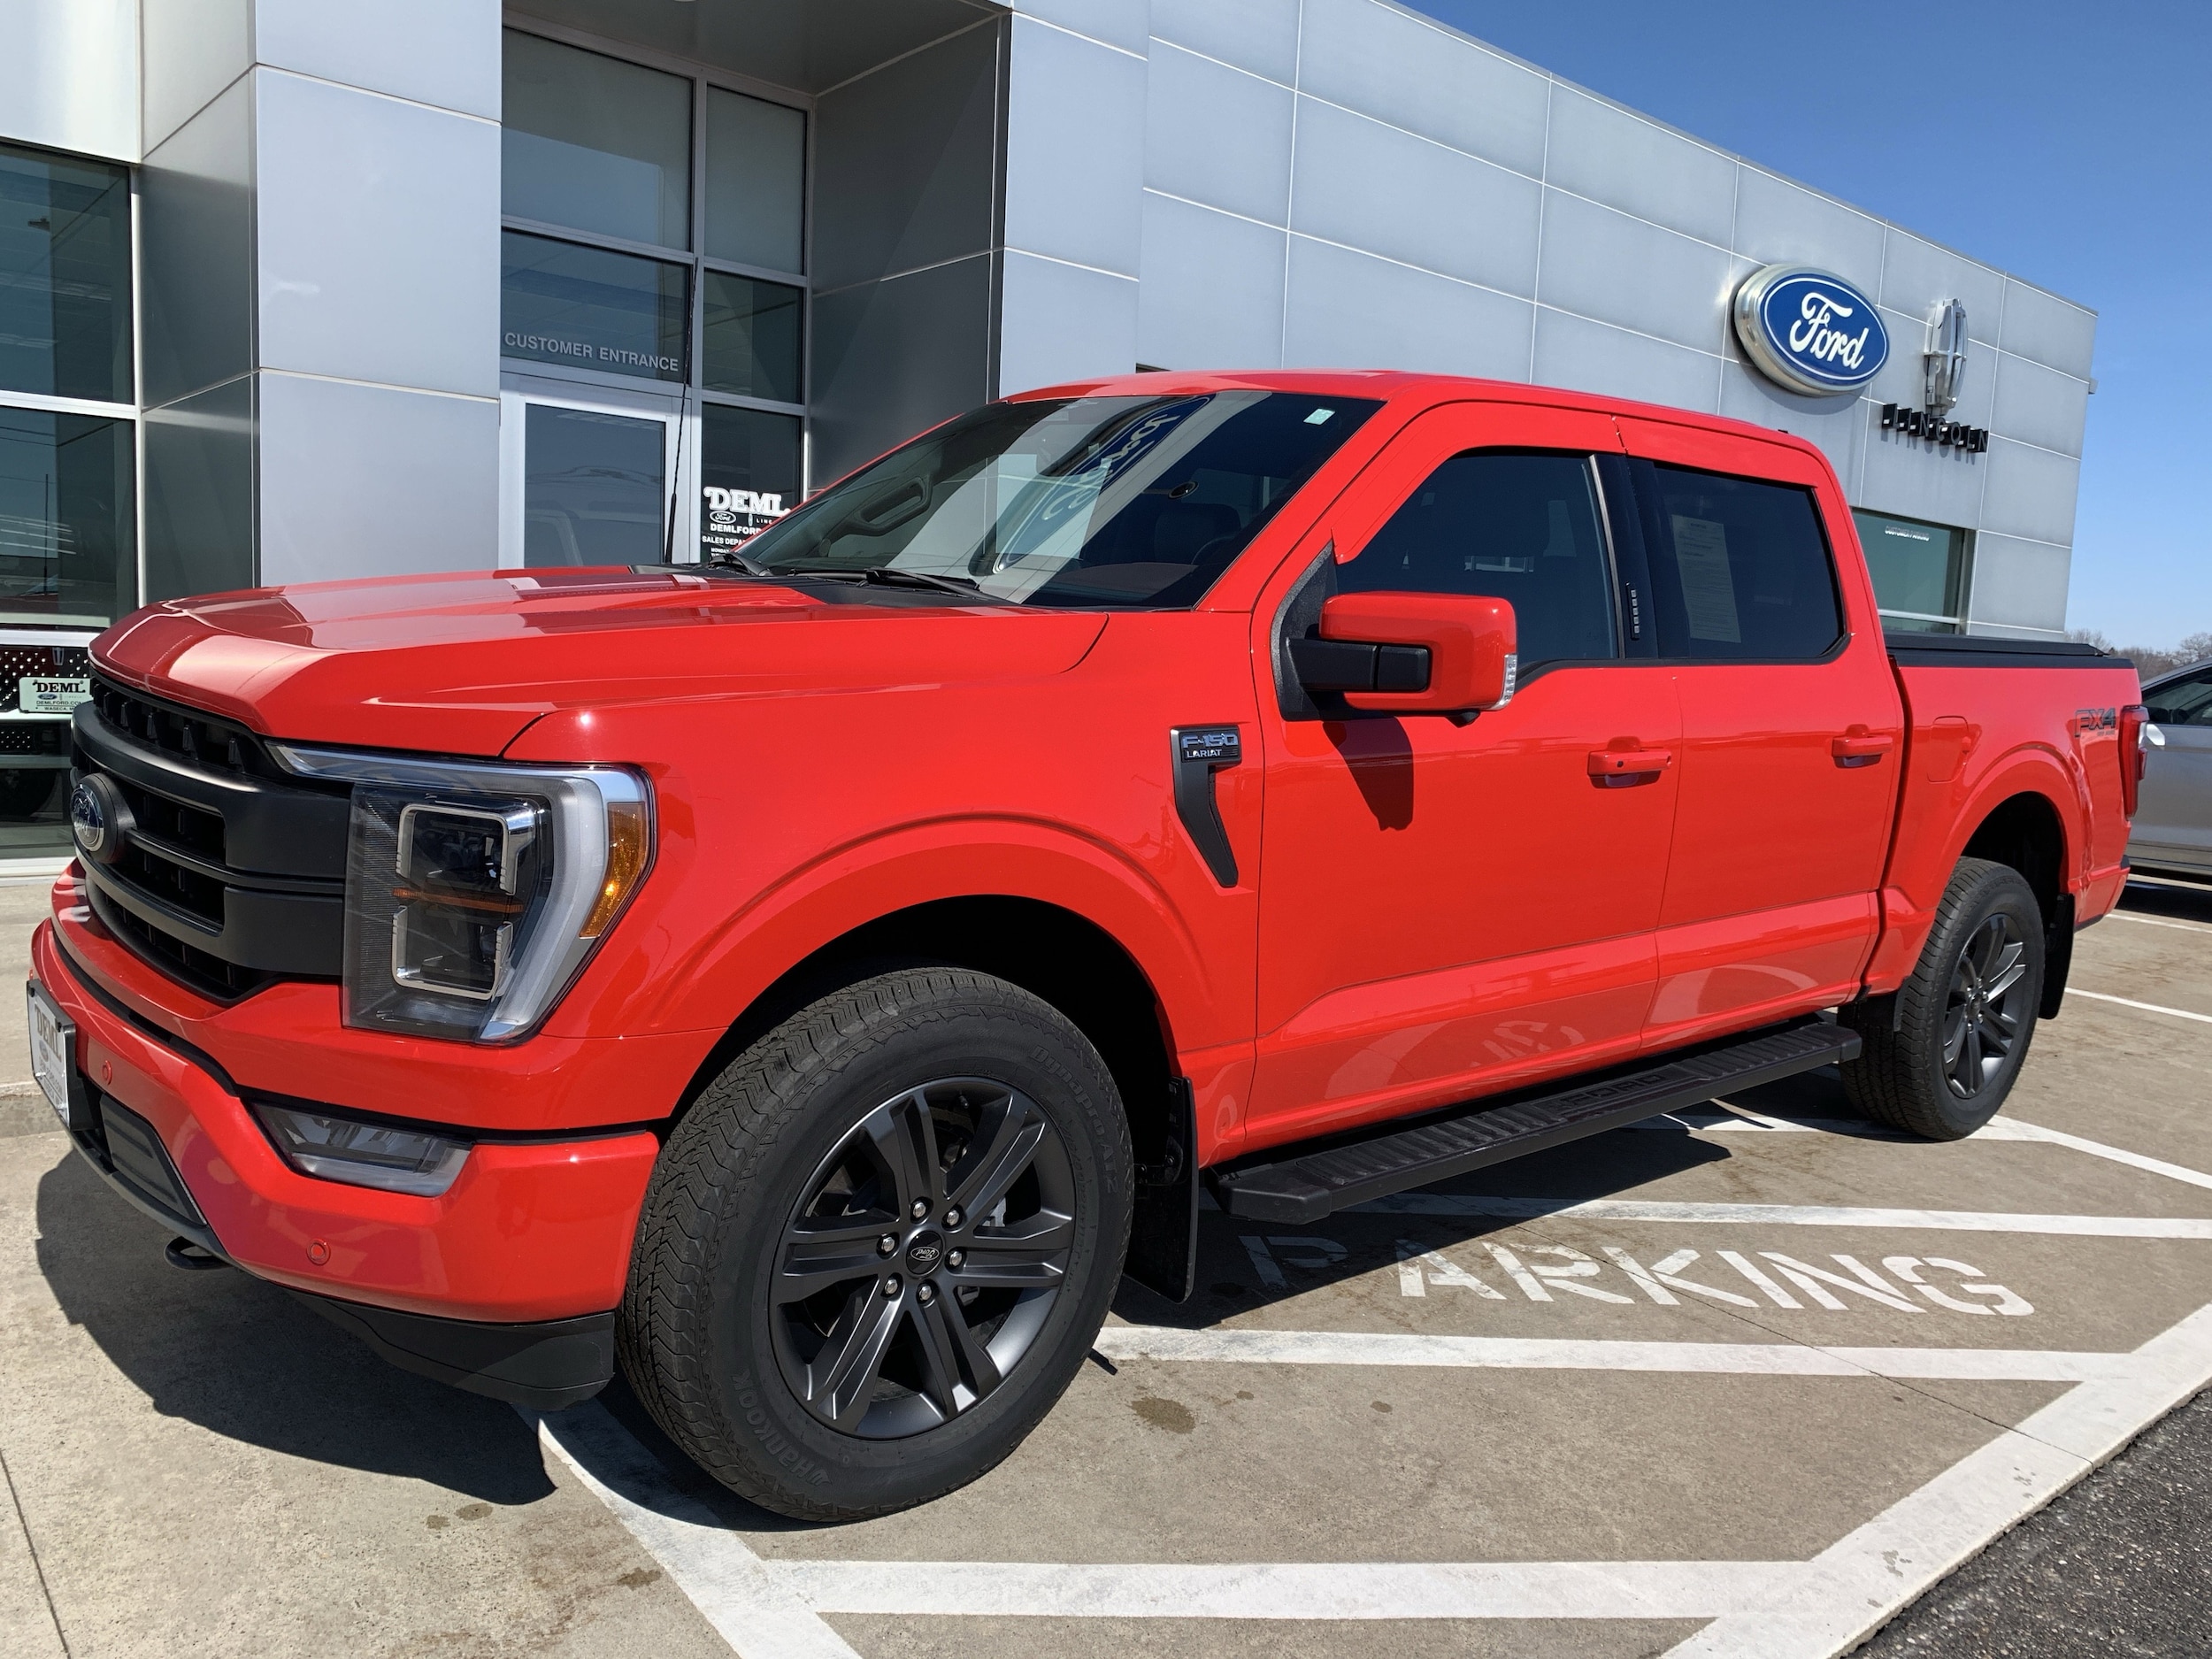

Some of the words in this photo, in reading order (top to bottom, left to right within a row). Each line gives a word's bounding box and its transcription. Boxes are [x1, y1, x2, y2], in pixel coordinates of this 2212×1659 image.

[1788, 291, 1870, 371] Ford
[504, 332, 593, 358] CUSTOMER
[599, 347, 679, 373] ENTRANCE
[703, 486, 791, 518] DEML
[702, 535, 724, 544] SALES
[710, 523, 763, 535] DEMLFORD
[32, 680, 86, 693] DEML
[2075, 707, 2116, 737] FX4
[1181, 733, 1239, 749] F-150
[1187, 749, 1222, 758] LARIAT
[1029, 1044, 1106, 1136] Dynapro
[1238, 1235, 2035, 1317] PARKING
